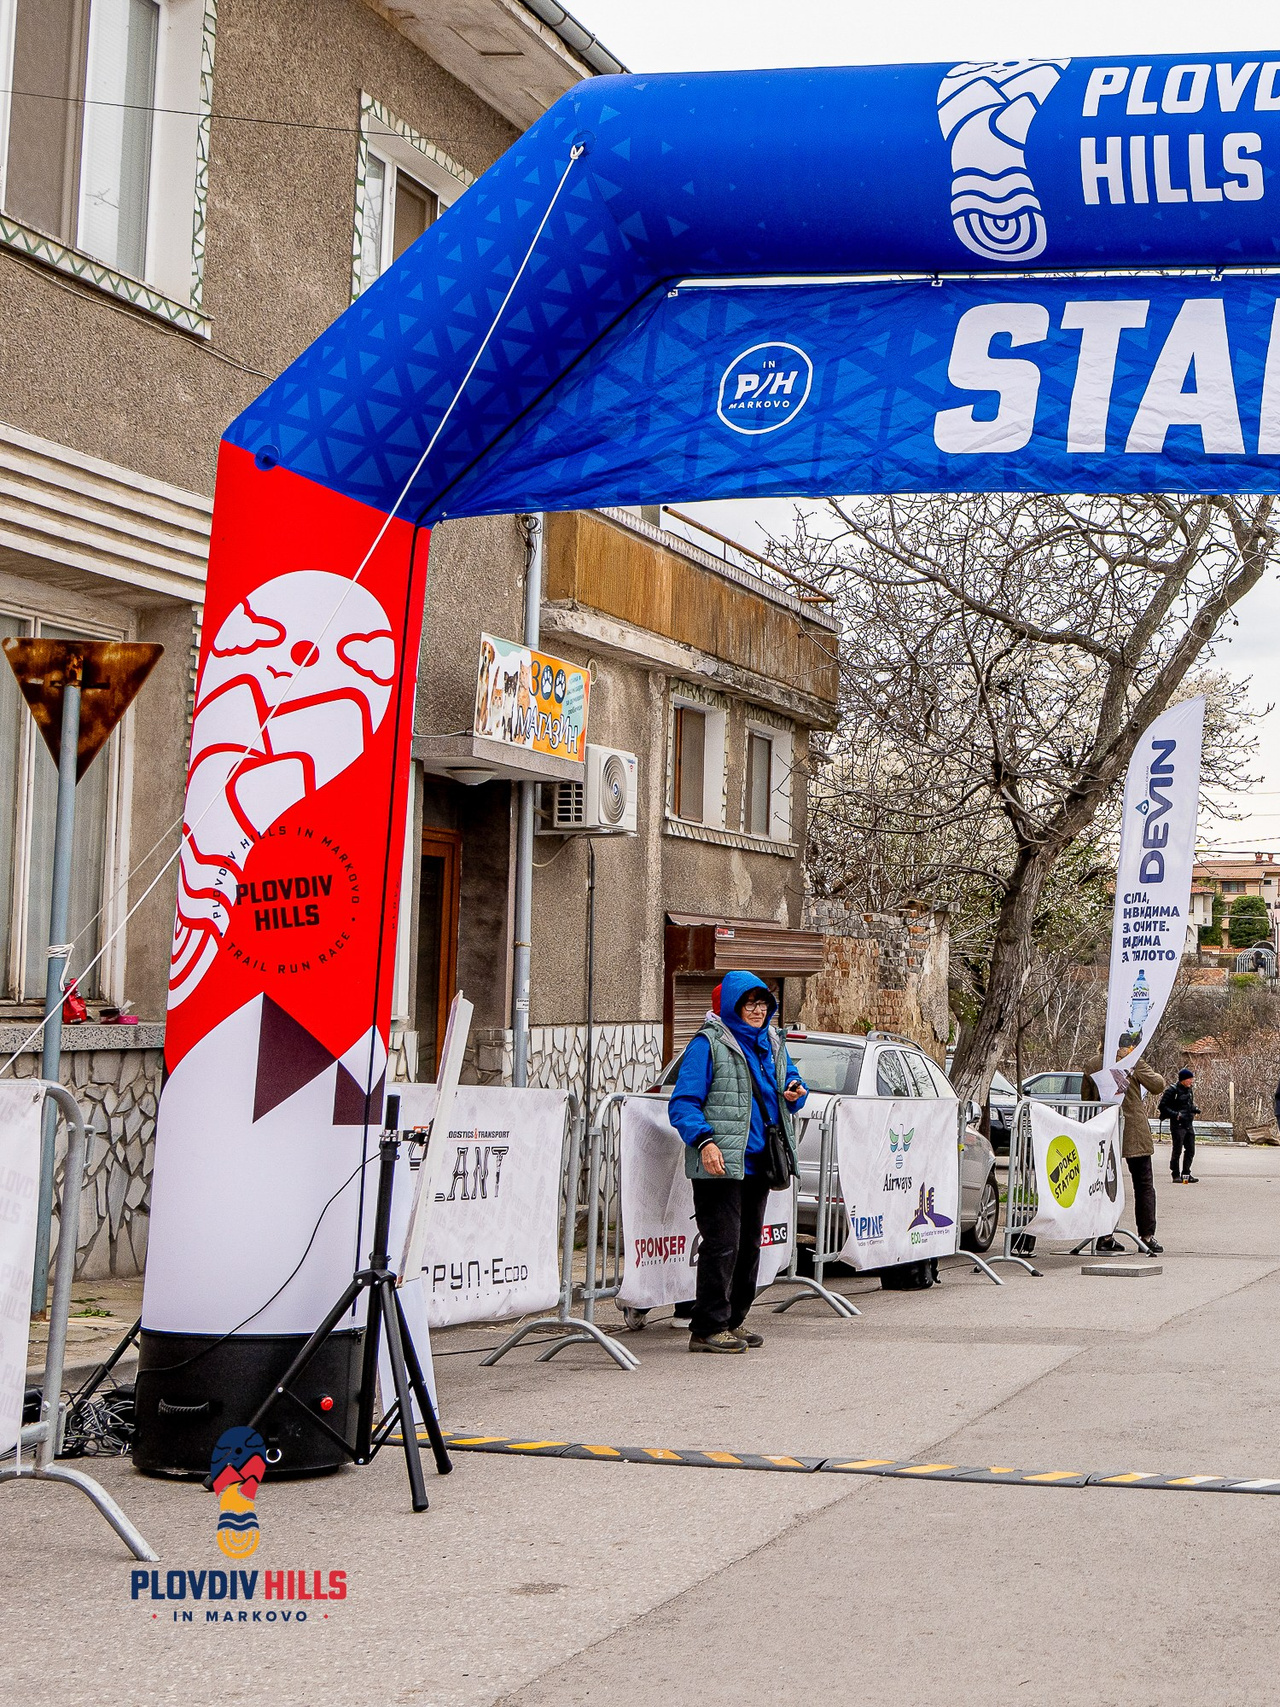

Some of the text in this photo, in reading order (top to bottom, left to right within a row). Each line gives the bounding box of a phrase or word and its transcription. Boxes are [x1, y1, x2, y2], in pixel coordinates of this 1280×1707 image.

[1080, 132, 1265, 204] HILLS
[734, 371, 798, 400] P/H
[728, 400, 790, 409] MARKOVO
[517, 706, 578, 754] МАГАЗИН
[1139, 739, 1177, 884] DEVIN
[213, 826, 360, 919] PLOVDIV HILLS IN MARKOVO
[235, 875, 333, 906] PLOVDIV
[254, 904, 320, 931] HILLS
[227, 931, 350, 974] TRAIL RUN RACE
[478, 1130, 510, 1138] TRANSPORT
[1059, 1149, 1077, 1173] POKE
[883, 1173, 912, 1193] Airways
[1055, 1163, 1080, 1199] STATION
[635, 1235, 686, 1268] SPONSER
